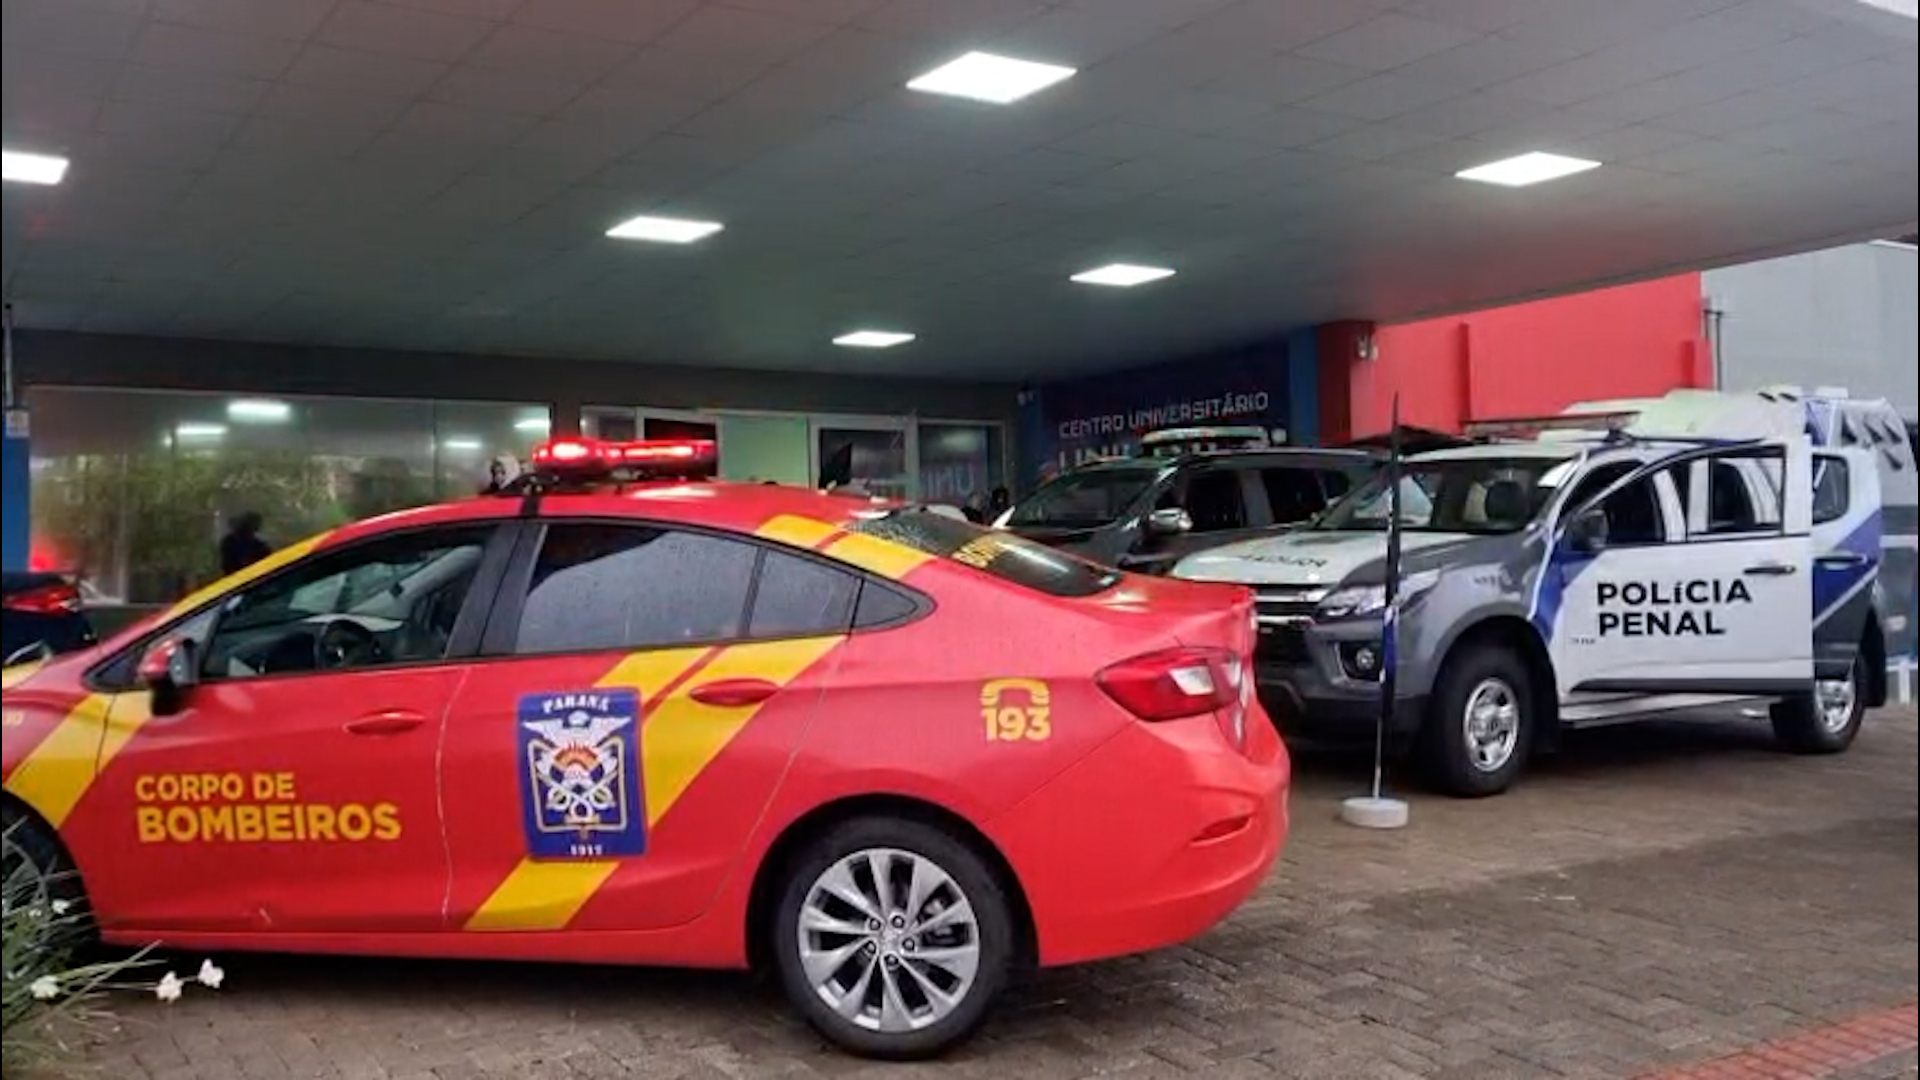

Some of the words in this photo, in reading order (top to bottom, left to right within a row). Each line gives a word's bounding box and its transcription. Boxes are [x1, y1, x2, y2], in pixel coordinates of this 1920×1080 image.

[1059, 414, 1125, 438] CENTRO
[1129, 392, 1269, 430] UNIVERSITÁRIO
[1599, 610, 1727, 637] PENAL
[980, 706, 1052, 742] 193
[136, 773, 243, 801] CORPO
[253, 772, 295, 800] DE
[138, 803, 402, 842] BOMBEIROS
